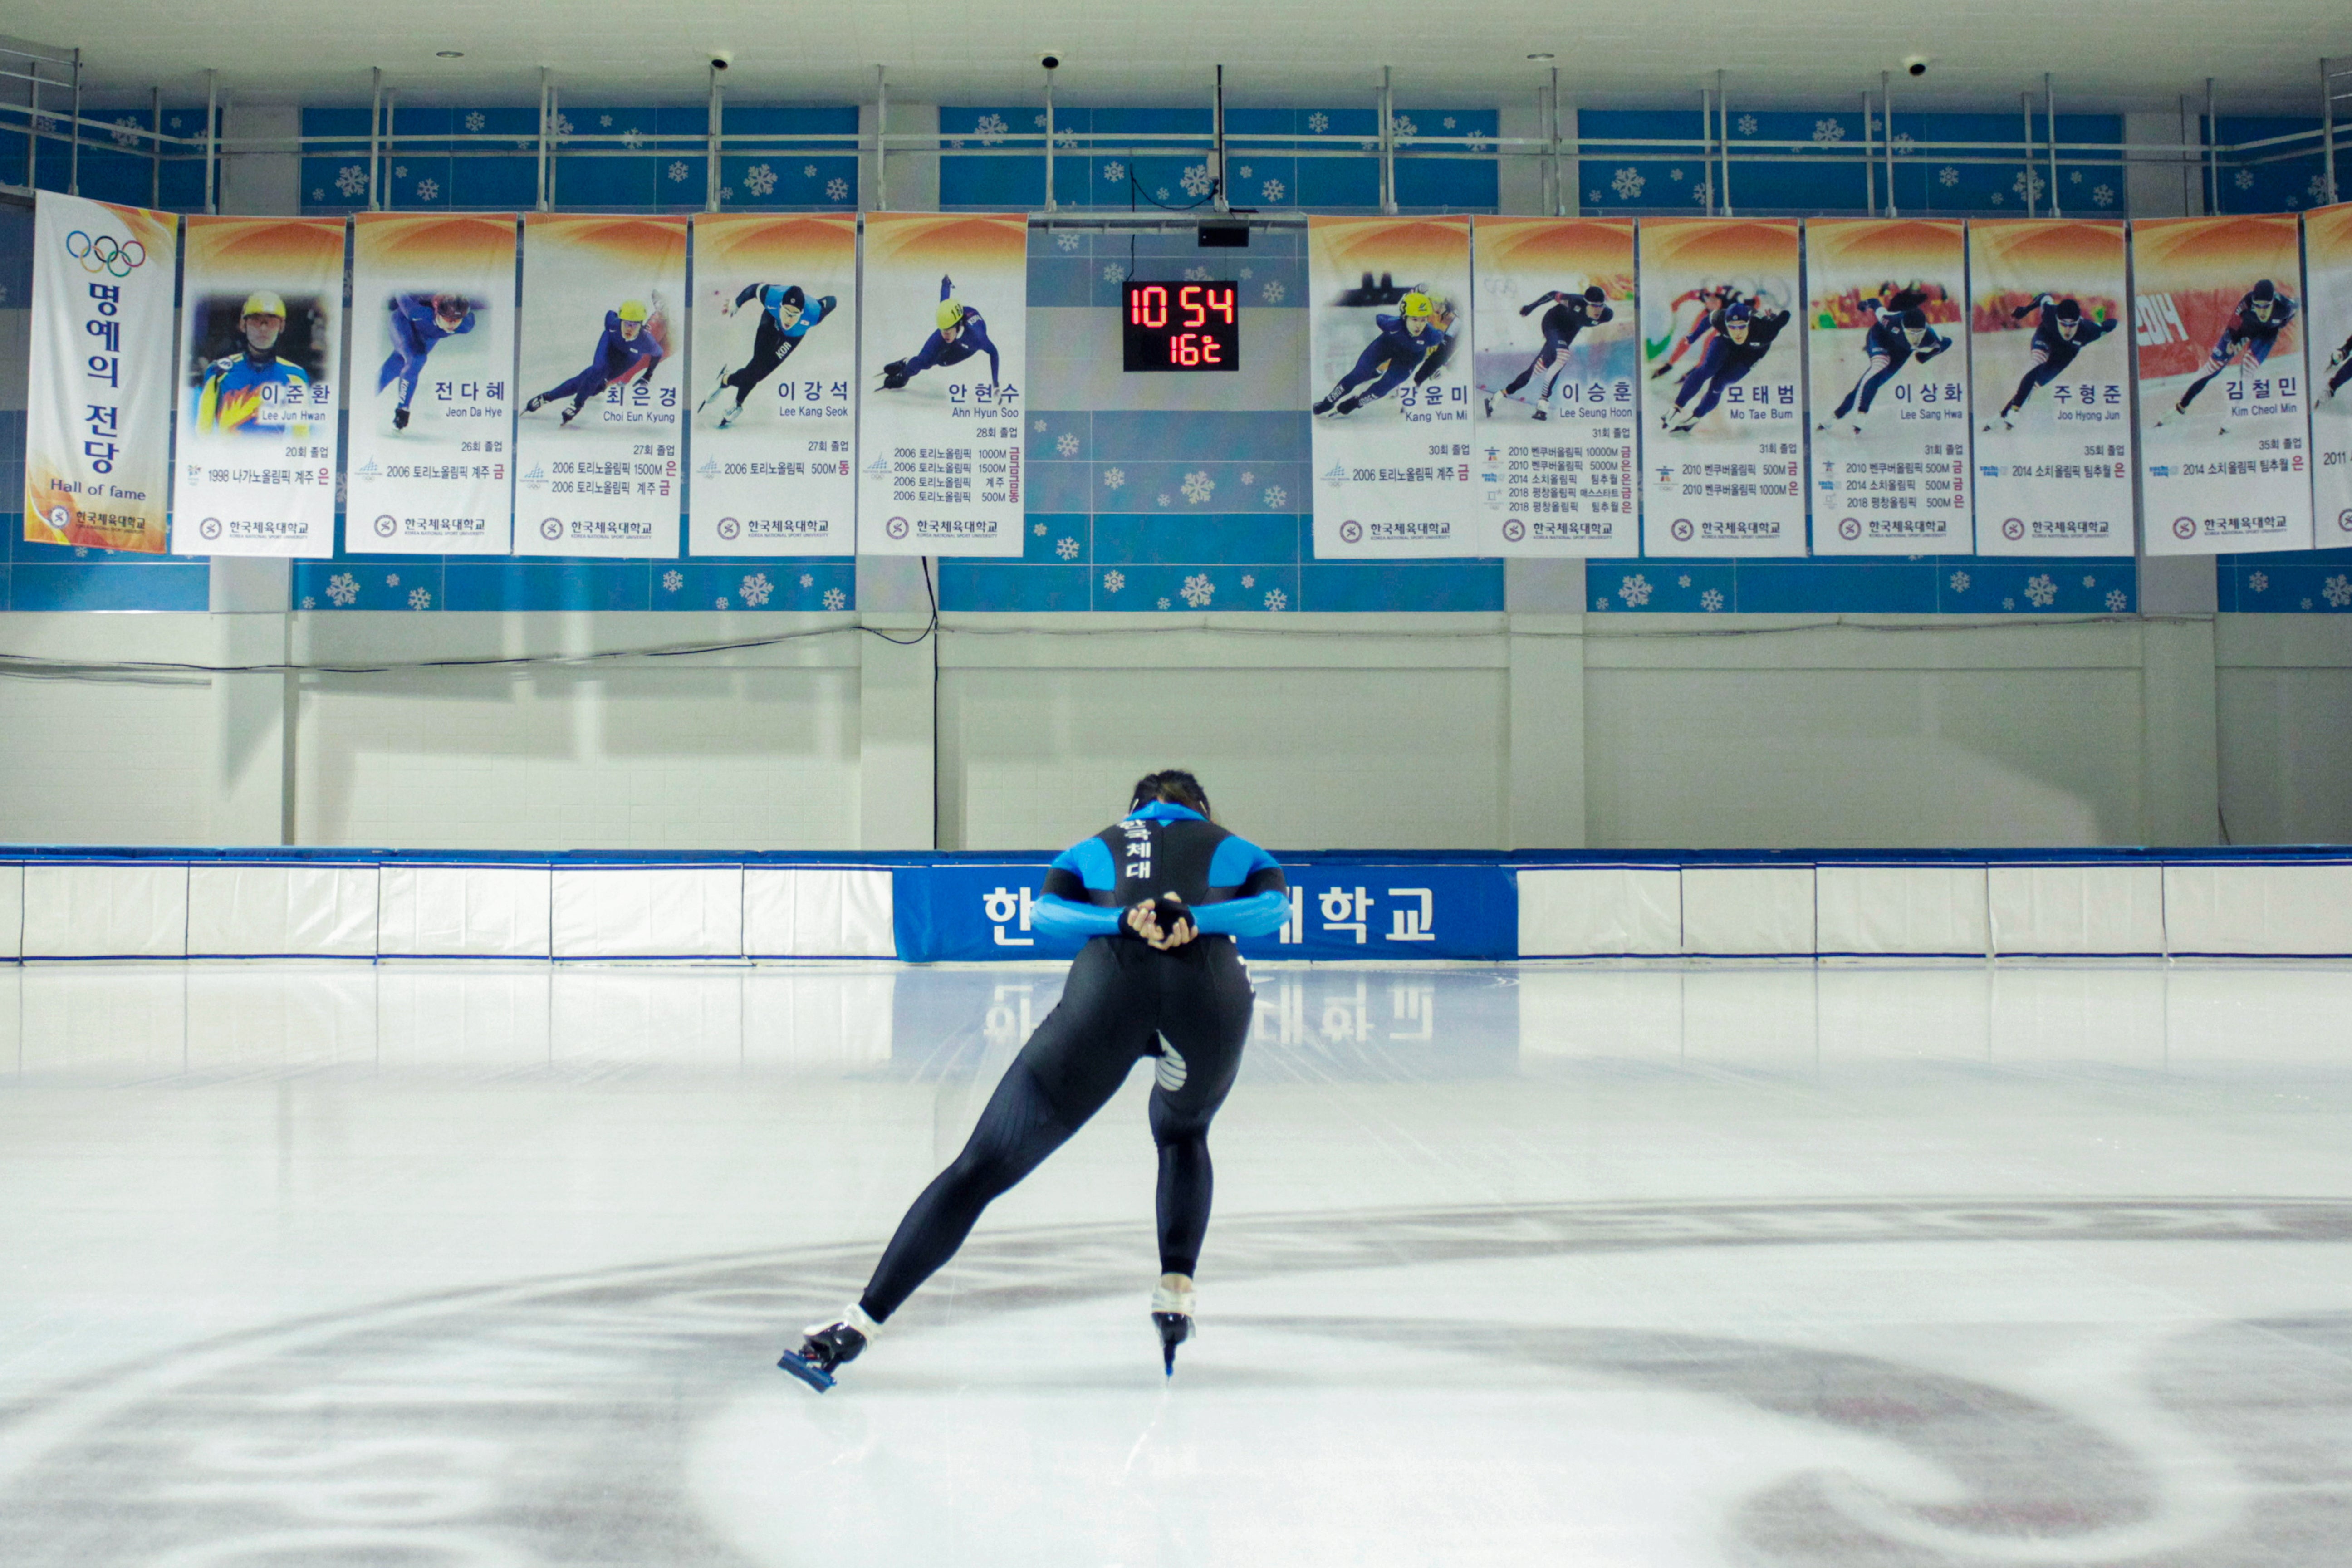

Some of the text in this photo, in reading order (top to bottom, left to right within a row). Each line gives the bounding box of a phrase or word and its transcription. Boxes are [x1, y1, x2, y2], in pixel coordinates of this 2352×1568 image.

[1132, 286, 1233, 328] 10 54
[775, 341, 792, 359] KOR
[263, 411, 325, 421] Lee Jun Hwan
[446, 407, 502, 418] Jeon Da Hye
[780, 406, 848, 417] Lee Kang Seok
[952, 407, 1019, 419] Ahn Hyun Soo
[1406, 410, 1467, 422] Kang Yun Mi
[1560, 407, 1632, 418] Lee Seung Hoon
[1730, 408, 1793, 419] Mo Tae Bum
[1901, 409, 1962, 421] Lee Sang Hwa
[2058, 411, 2073, 420] Joo
[2105, 411, 2120, 420] Jun
[2232, 403, 2297, 416] Kim Cheol Min
[603, 411, 675, 423] Choi Eun Kyung
[976, 427, 1017, 438] 28회 졸업
[462, 441, 502, 452] 26회 졸업
[634, 445, 675, 456] 27회 졸업
[808, 441, 848, 451] 27회 졸업
[1429, 444, 1470, 455] 30회 졸업
[2259, 438, 2302, 450] 35회 졸업
[286, 446, 328, 458] 20회 졸업
[894, 447, 1020, 461] 2006 토리노올림픽 1000M 금
[2324, 451, 2346, 465] 2011
[387, 464, 504, 479] 2006 토리노올림픽 계주 금
[553, 461, 676, 476] 2006 토리노올림픽 1500M 은
[725, 460, 849, 475] 2006 토리노올림픽 500M 동
[894, 461, 1020, 475] 2006 토리노올림픽 1500M 금
[1682, 464, 1701, 475] 2010
[1764, 464, 1786, 475] 500M
[1788, 462, 1798, 476] 금
[1847, 463, 1867, 473] 2010
[1926, 463, 1949, 473] 500M
[1953, 461, 1963, 474] 금
[2013, 465, 2032, 476] 2014
[2036, 465, 2080, 478] 소치올림픽
[2114, 463, 2125, 478] 은
[2184, 464, 2205, 475] 2014
[2208, 460, 2256, 475] 소치올림픽
[2292, 456, 2303, 471] 은
[208, 468, 329, 485] 1998 나가노올림픽 계주 은
[1353, 469, 1376, 481] 2006
[1379, 467, 1433, 482] 토리노올림픽
[1437, 467, 1454, 480] 계주
[1458, 464, 1469, 481] 금
[50, 478, 146, 500] Hall of fame
[552, 480, 670, 495] 2006 토리노올림픽 계주 금
[894, 476, 1019, 489] 2006 토리노올림픽 계주 금
[1683, 484, 1703, 495] 2010
[1760, 485, 1787, 495] 1000M
[1788, 481, 1798, 496] 은
[1847, 480, 1867, 490] 2014
[1870, 480, 1915, 491] 소치올림픽
[1926, 480, 1950, 490] 500M
[1953, 477, 1963, 491] 금
[894, 490, 1019, 503] 2006 토리노올림픽 500M 동
[1509, 488, 1529, 497] 2018
[1622, 487, 1632, 499] 금
[76, 511, 145, 529] 한국체육대학교
[405, 519, 485, 530] 한국체육대학교
[749, 520, 828, 532] 한국체육대학교
[917, 520, 997, 533] 한국체육대학교
[2204, 516, 2286, 531] 한국체육대학교
[230, 521, 308, 534] 한국체육대학교
[572, 521, 651, 534] 한국체육대학교
[1371, 523, 1450, 535] 한국체육대학교
[1702, 522, 1780, 534] 한국체육대학교
[1870, 521, 1946, 533] 한국체육대학교
